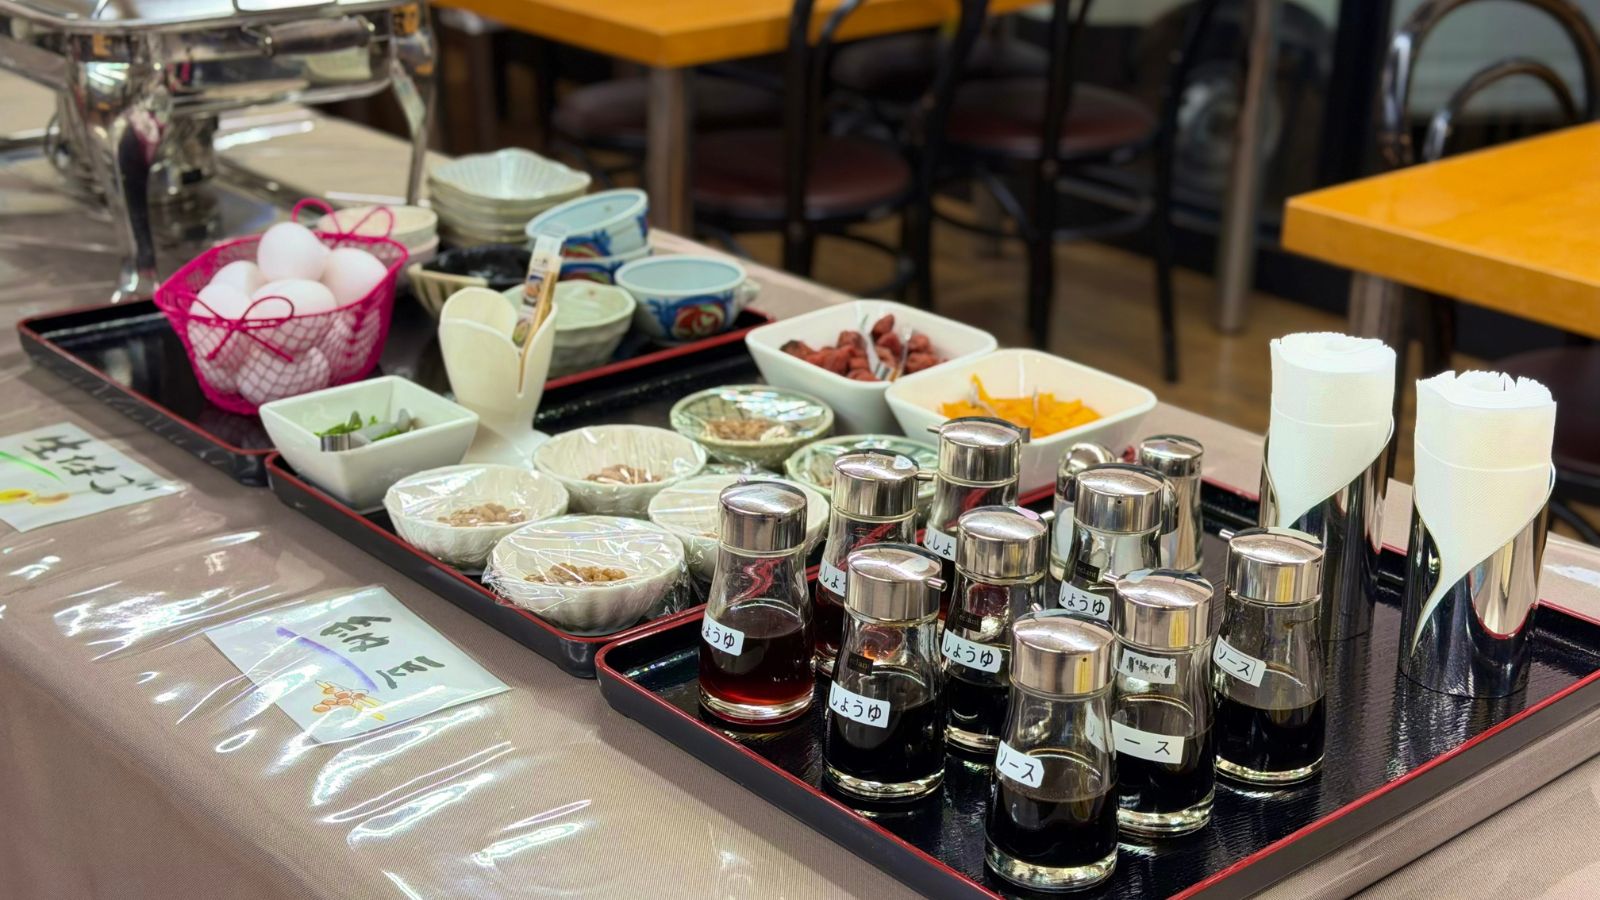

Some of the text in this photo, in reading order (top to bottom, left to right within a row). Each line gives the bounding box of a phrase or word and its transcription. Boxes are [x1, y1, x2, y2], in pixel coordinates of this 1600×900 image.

[1060, 587, 1105, 616] しょうゆ
[702, 623, 735, 649] ょうゆ
[944, 635, 994, 668] しょうゆ
[319, 616, 445, 690] 納豆
[1219, 647, 1250, 676] ソース
[831, 690, 882, 722] しょうゆ
[1000, 749, 1036, 782] ソース
